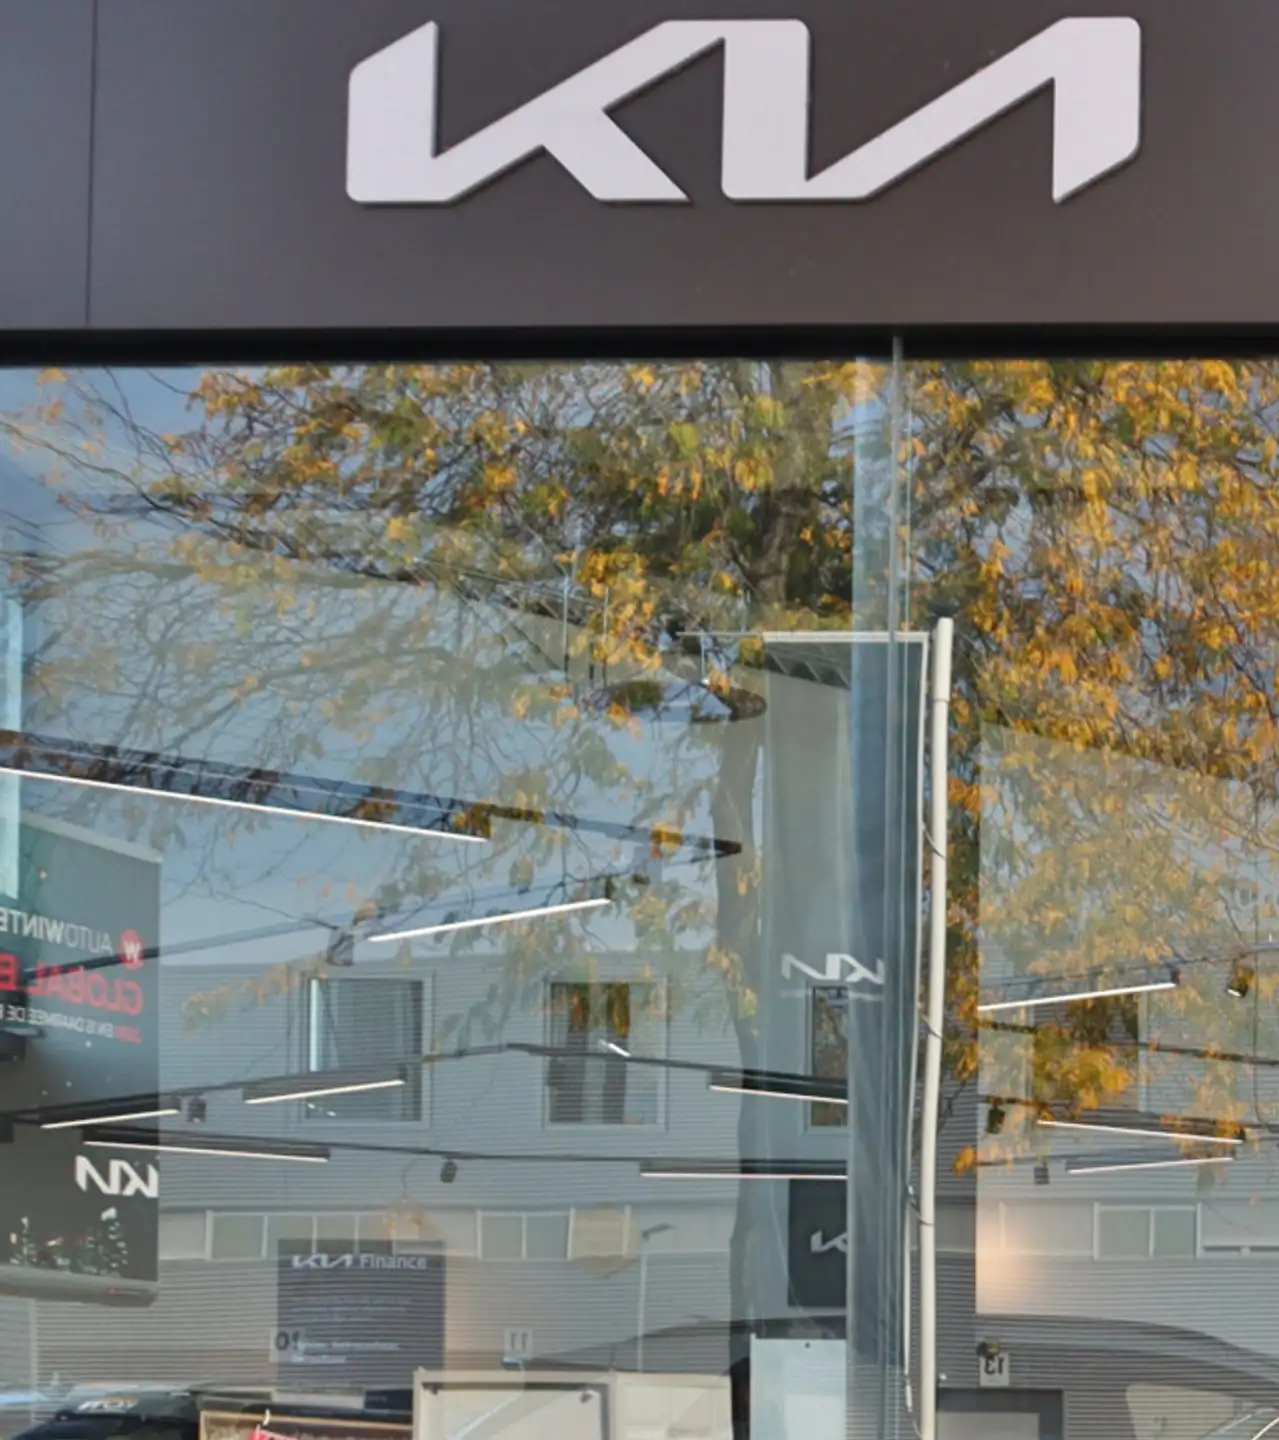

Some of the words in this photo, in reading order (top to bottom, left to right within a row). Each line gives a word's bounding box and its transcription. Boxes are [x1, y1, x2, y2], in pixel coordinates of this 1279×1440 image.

[346, 17, 1141, 204] KIA
[292, 1253, 353, 1269] KIA
[361, 1253, 428, 1270] Finance
